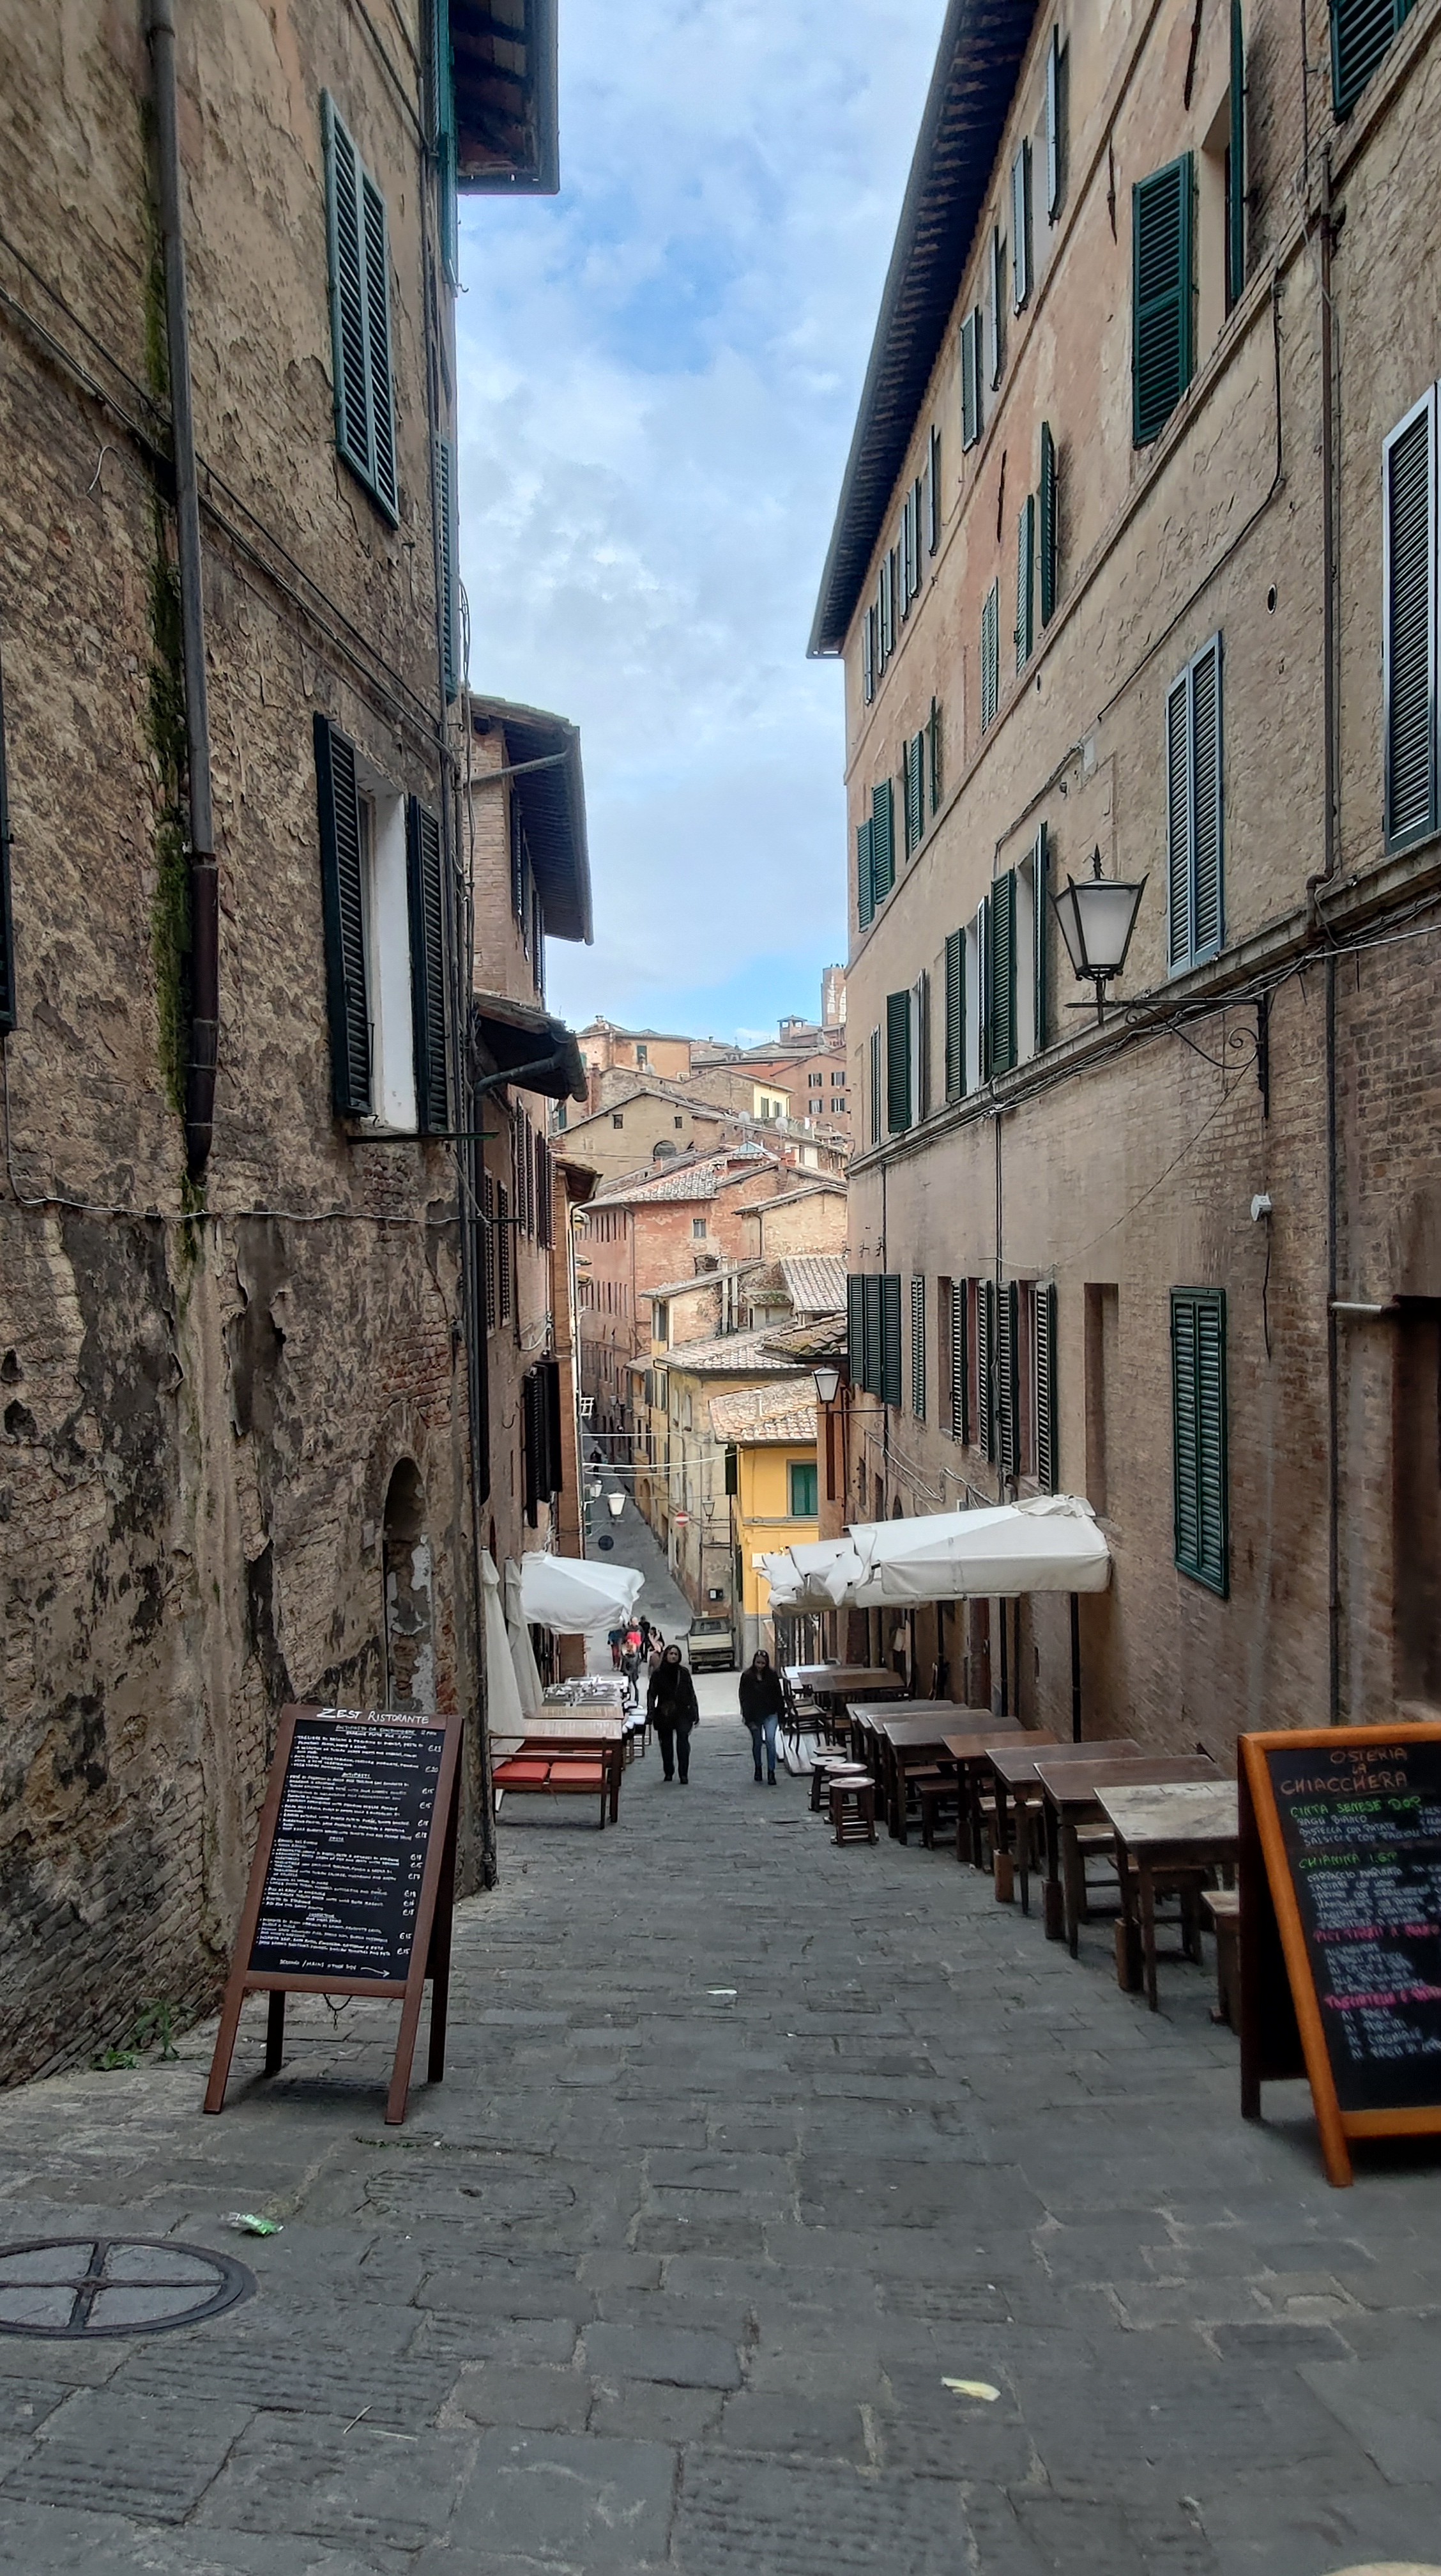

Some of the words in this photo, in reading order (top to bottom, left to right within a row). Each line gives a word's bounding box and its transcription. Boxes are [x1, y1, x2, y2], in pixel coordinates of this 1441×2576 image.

[316, 1708, 362, 1719] ZEST
[367, 1711, 429, 1724] RISTORANTE
[1330, 1747, 1407, 1763] OSTERIA
[1352, 1763, 1367, 1774] LA
[1281, 1771, 1407, 1795] CHIACCHERA
[1290, 1804, 1328, 1818] CINTA
[1337, 1800, 1382, 1813] SENESE
[1299, 1853, 1360, 1869] CHIANINA
